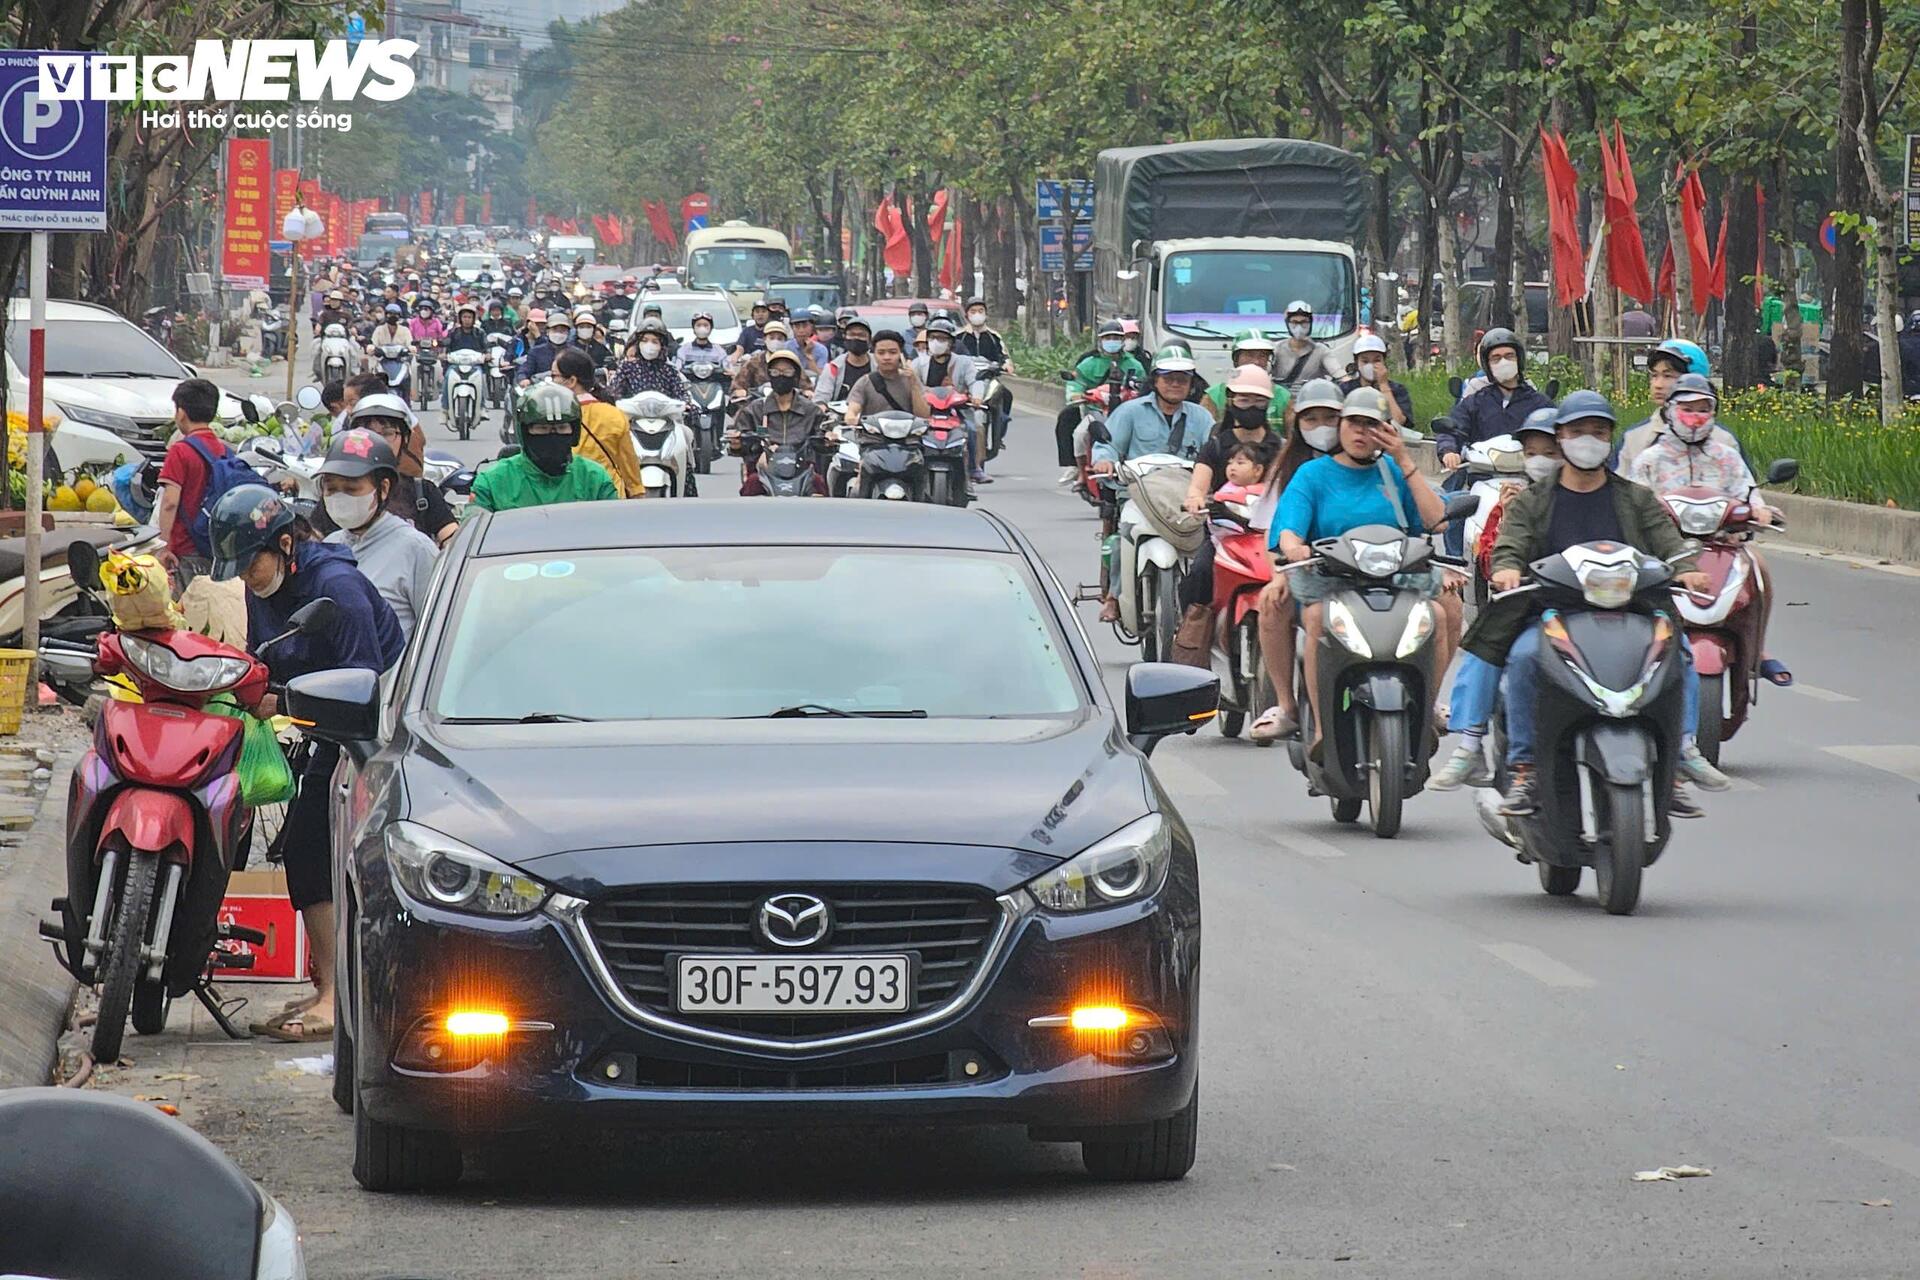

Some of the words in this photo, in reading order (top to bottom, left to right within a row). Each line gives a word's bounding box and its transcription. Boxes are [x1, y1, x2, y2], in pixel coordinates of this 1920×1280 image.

[7, 56, 40, 68] PHƯỜN
[0, 166, 32, 182] ÔNG
[35, 169, 52, 182] TY
[55, 170, 91, 183] TNHH
[0, 184, 17, 200] ẤN
[20, 186, 68, 201] QUỲNH
[71, 189, 100, 202] ANH
[687, 964, 900, 1006] 30F-597.93
